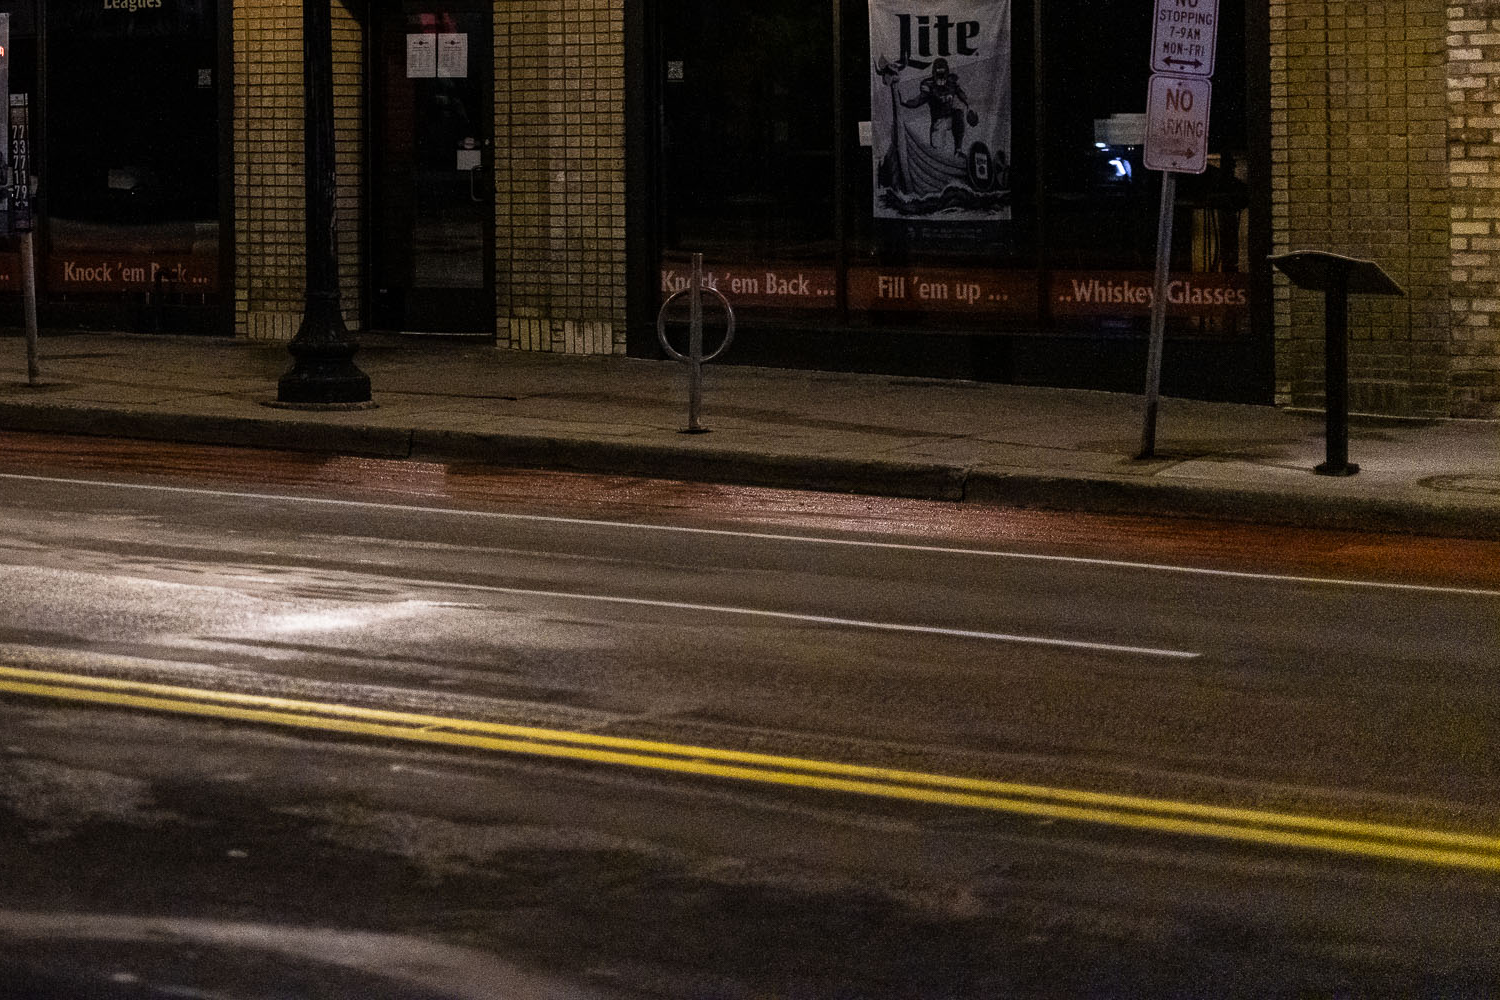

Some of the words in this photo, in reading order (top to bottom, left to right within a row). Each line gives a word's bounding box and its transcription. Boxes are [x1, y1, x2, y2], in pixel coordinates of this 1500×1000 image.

[1159, 9, 1213, 26] STOPPING
[894, 13, 980, 70] Lite
[1169, 26, 1201, 41] 7-9AM
[1162, 41, 1205, 57] MON-FRI
[1166, 88, 1194, 112] NO
[1160, 118, 1204, 138] ARKING
[64, 261, 113, 282] Knock
[765, 272, 810, 295] Back
[878, 275, 905, 299] Fill
[955, 283, 981, 305] up
[1167, 280, 1246, 305] Glasses
